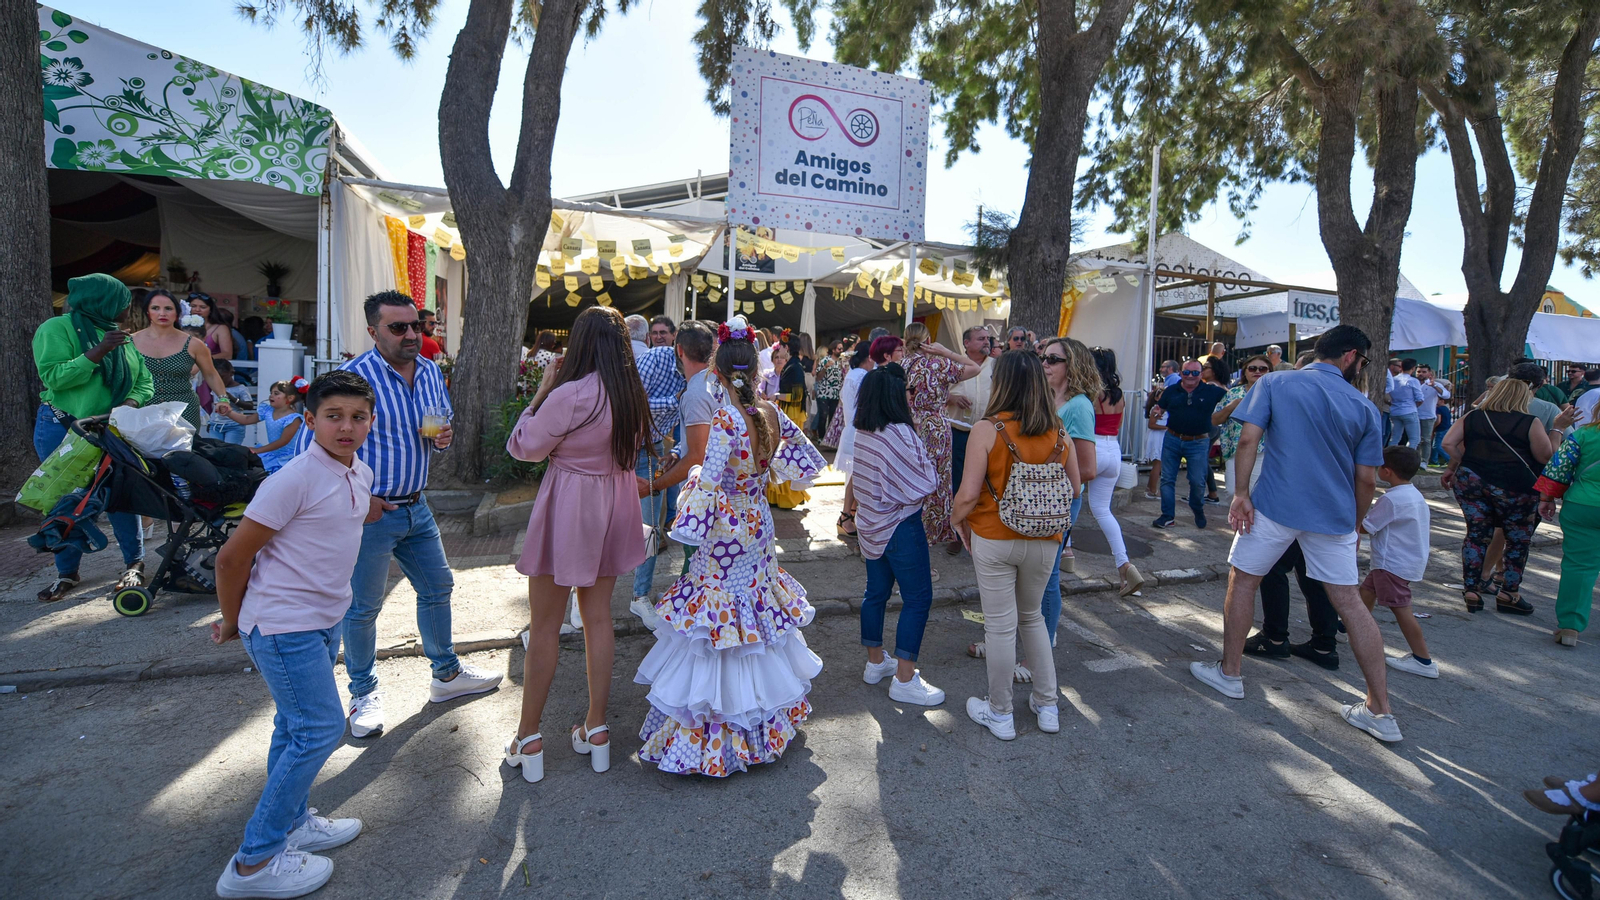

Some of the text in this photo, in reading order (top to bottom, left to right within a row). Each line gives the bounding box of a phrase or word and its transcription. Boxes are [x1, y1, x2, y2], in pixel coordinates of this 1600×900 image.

[794, 150, 871, 176] Amigos
[775, 168, 888, 197] del Camino
[598, 246, 616, 254] Canasta
[767, 246, 782, 254] Canasta
[783, 249, 798, 258] Canasta
[1293, 297, 1340, 324] tres,c
